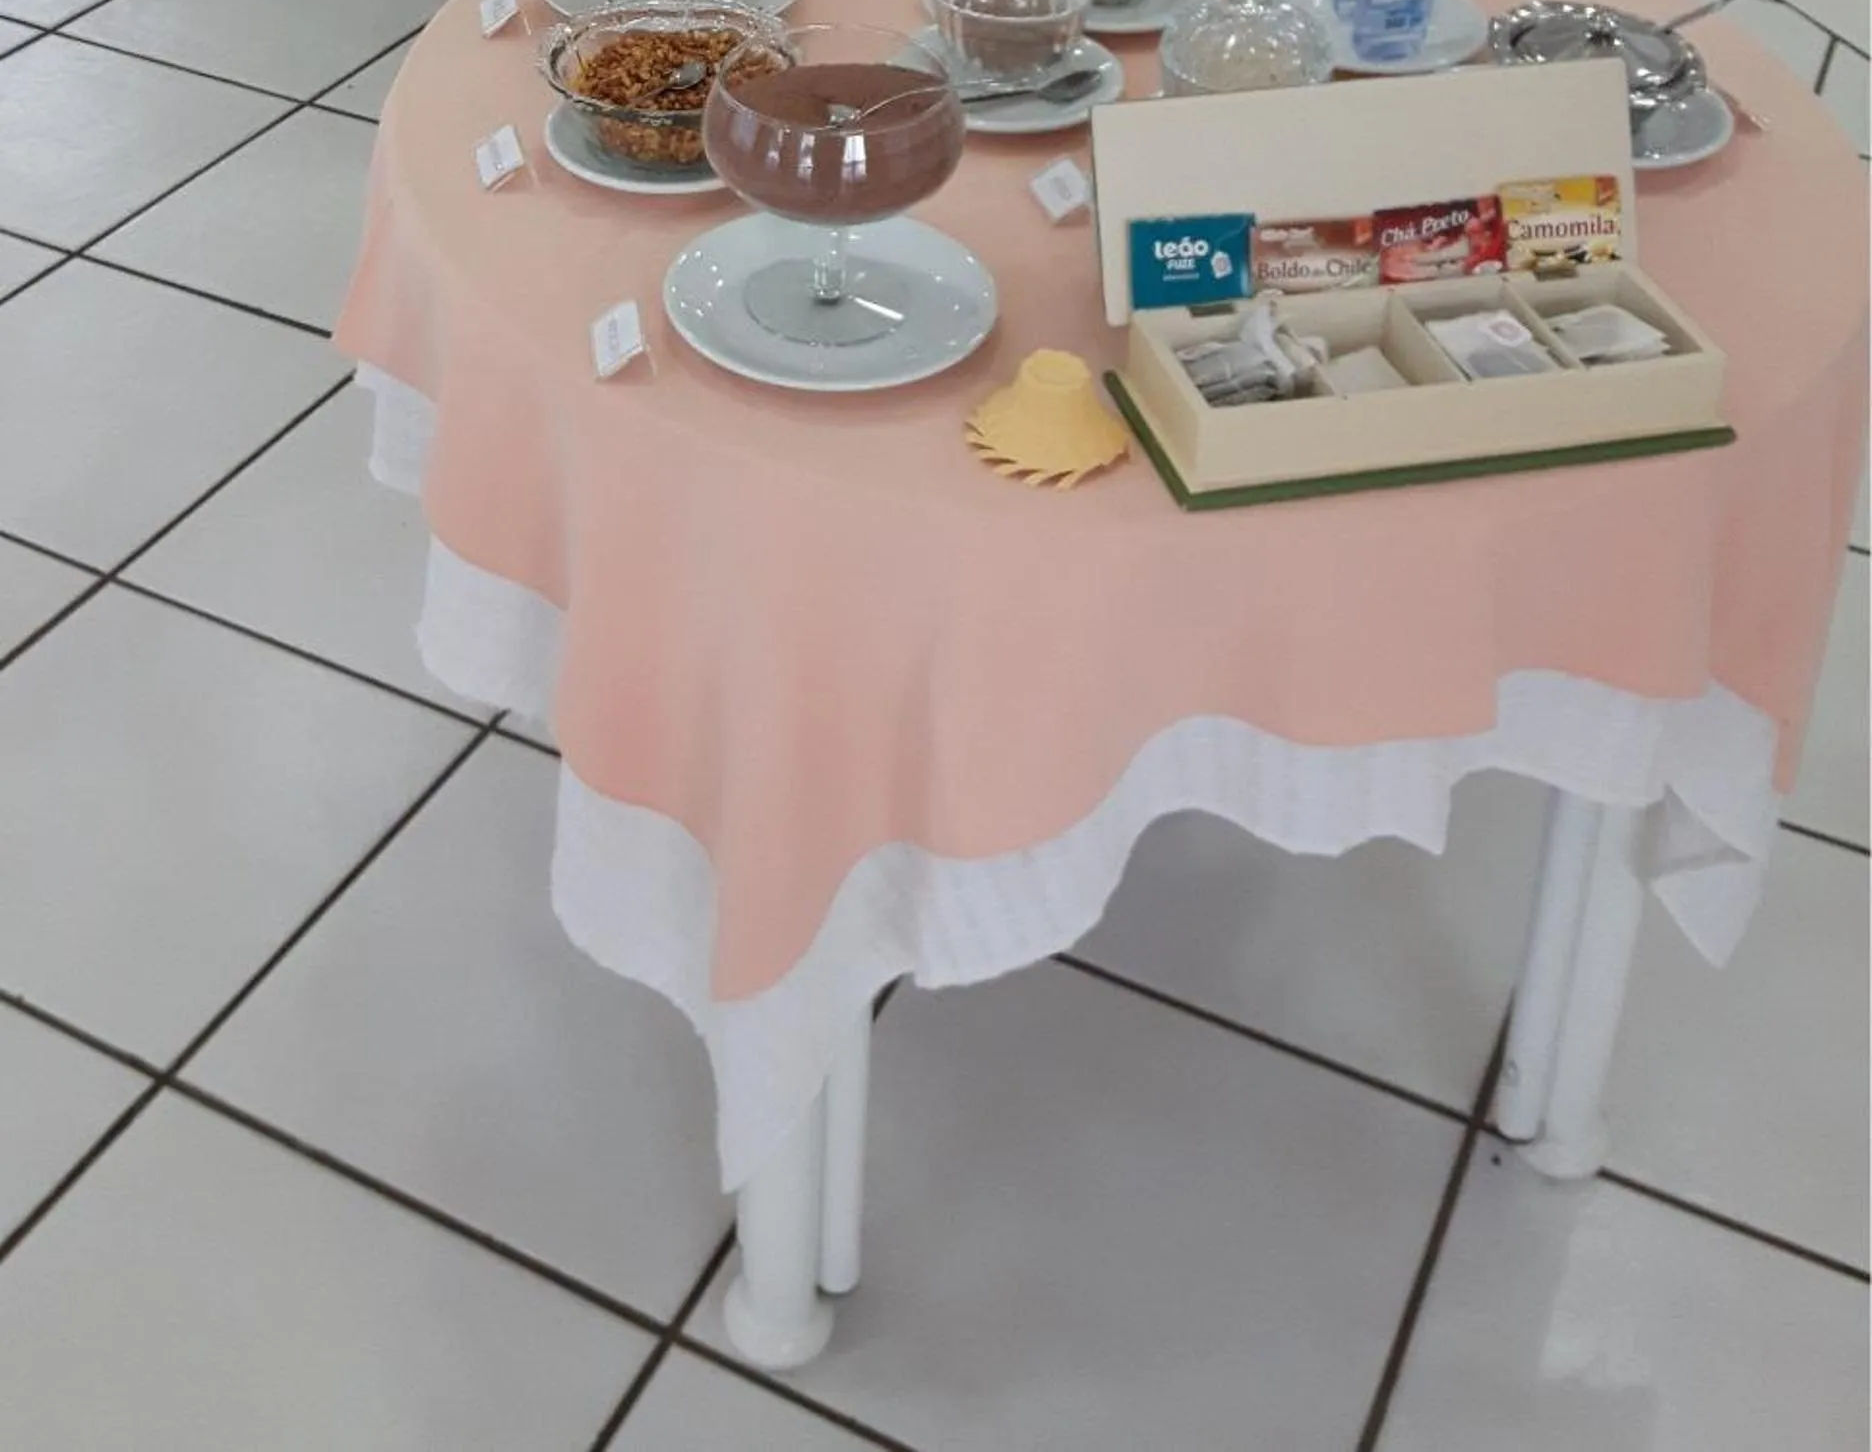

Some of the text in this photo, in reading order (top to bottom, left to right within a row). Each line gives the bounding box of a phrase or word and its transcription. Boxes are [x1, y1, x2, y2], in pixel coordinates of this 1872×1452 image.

[1381, 209, 1470, 247] Chá Preto
[1506, 214, 1616, 241] Camomila
[1257, 259, 1310, 280] Boldo
